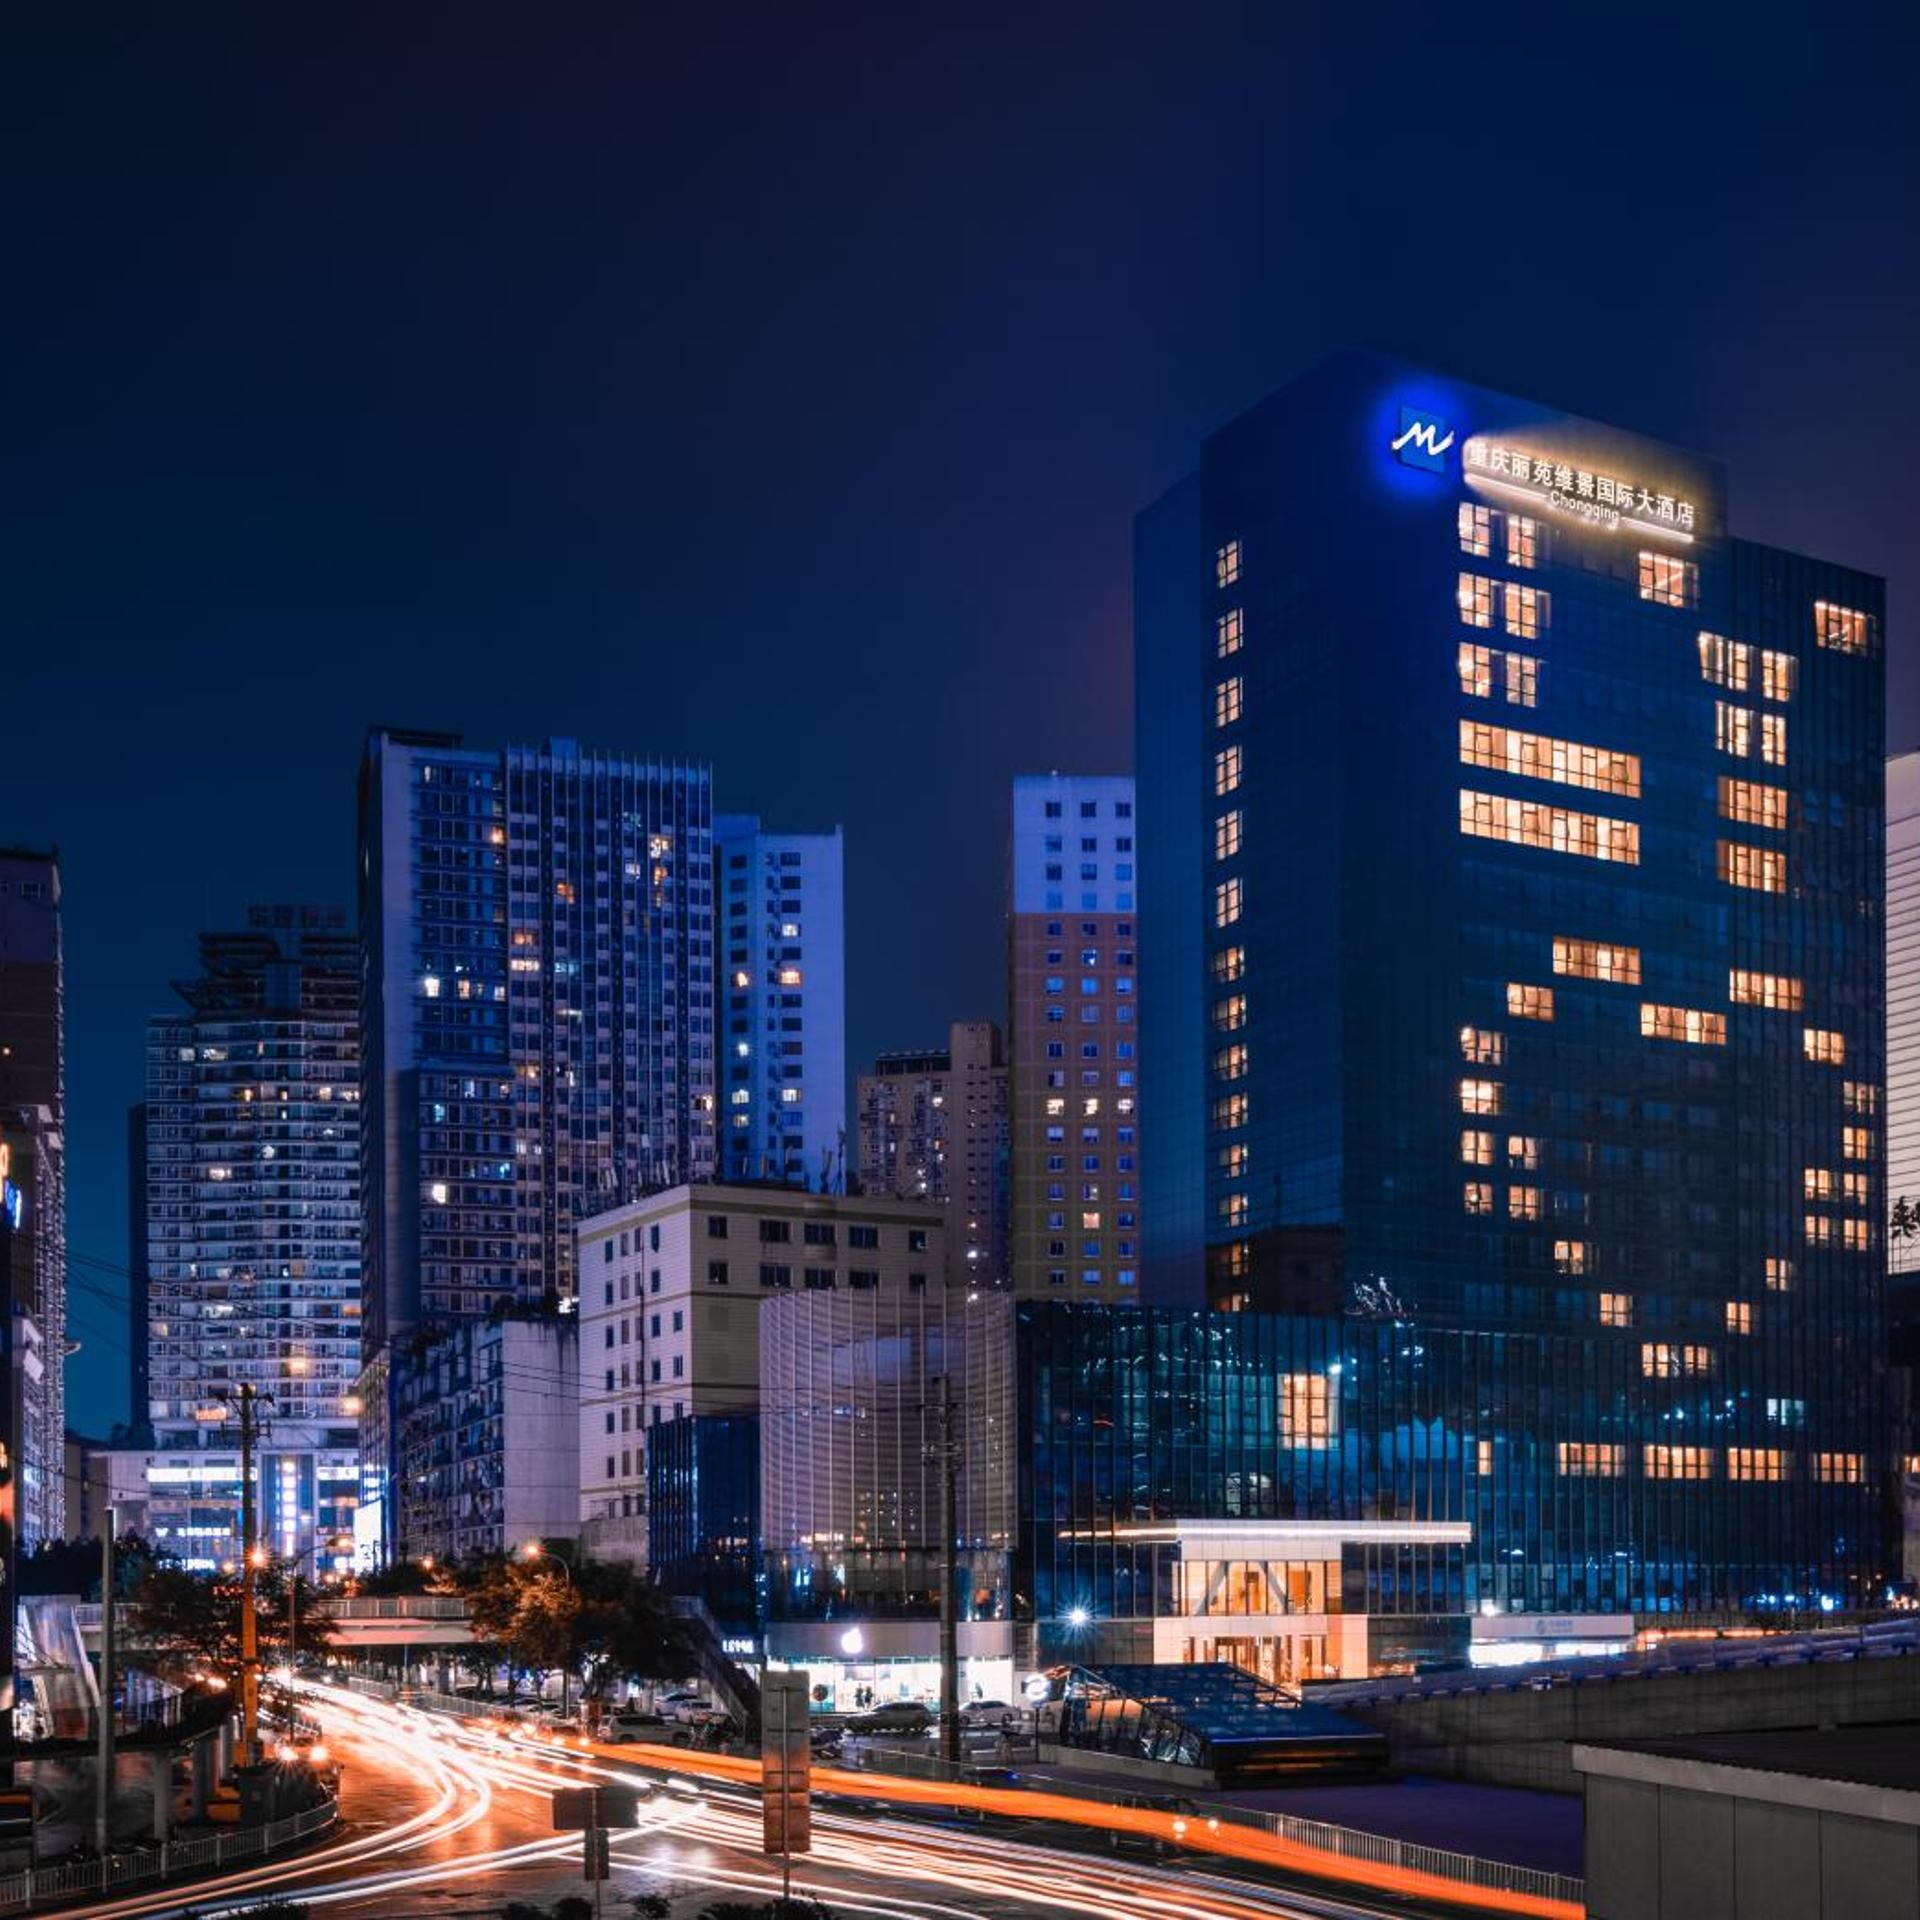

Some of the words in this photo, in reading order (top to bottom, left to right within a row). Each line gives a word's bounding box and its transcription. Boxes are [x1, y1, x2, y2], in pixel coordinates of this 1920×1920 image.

[1468, 442, 1695, 528] 重庆丽苑维景国际大酒店
[1550, 490, 1620, 528] Chongqing
